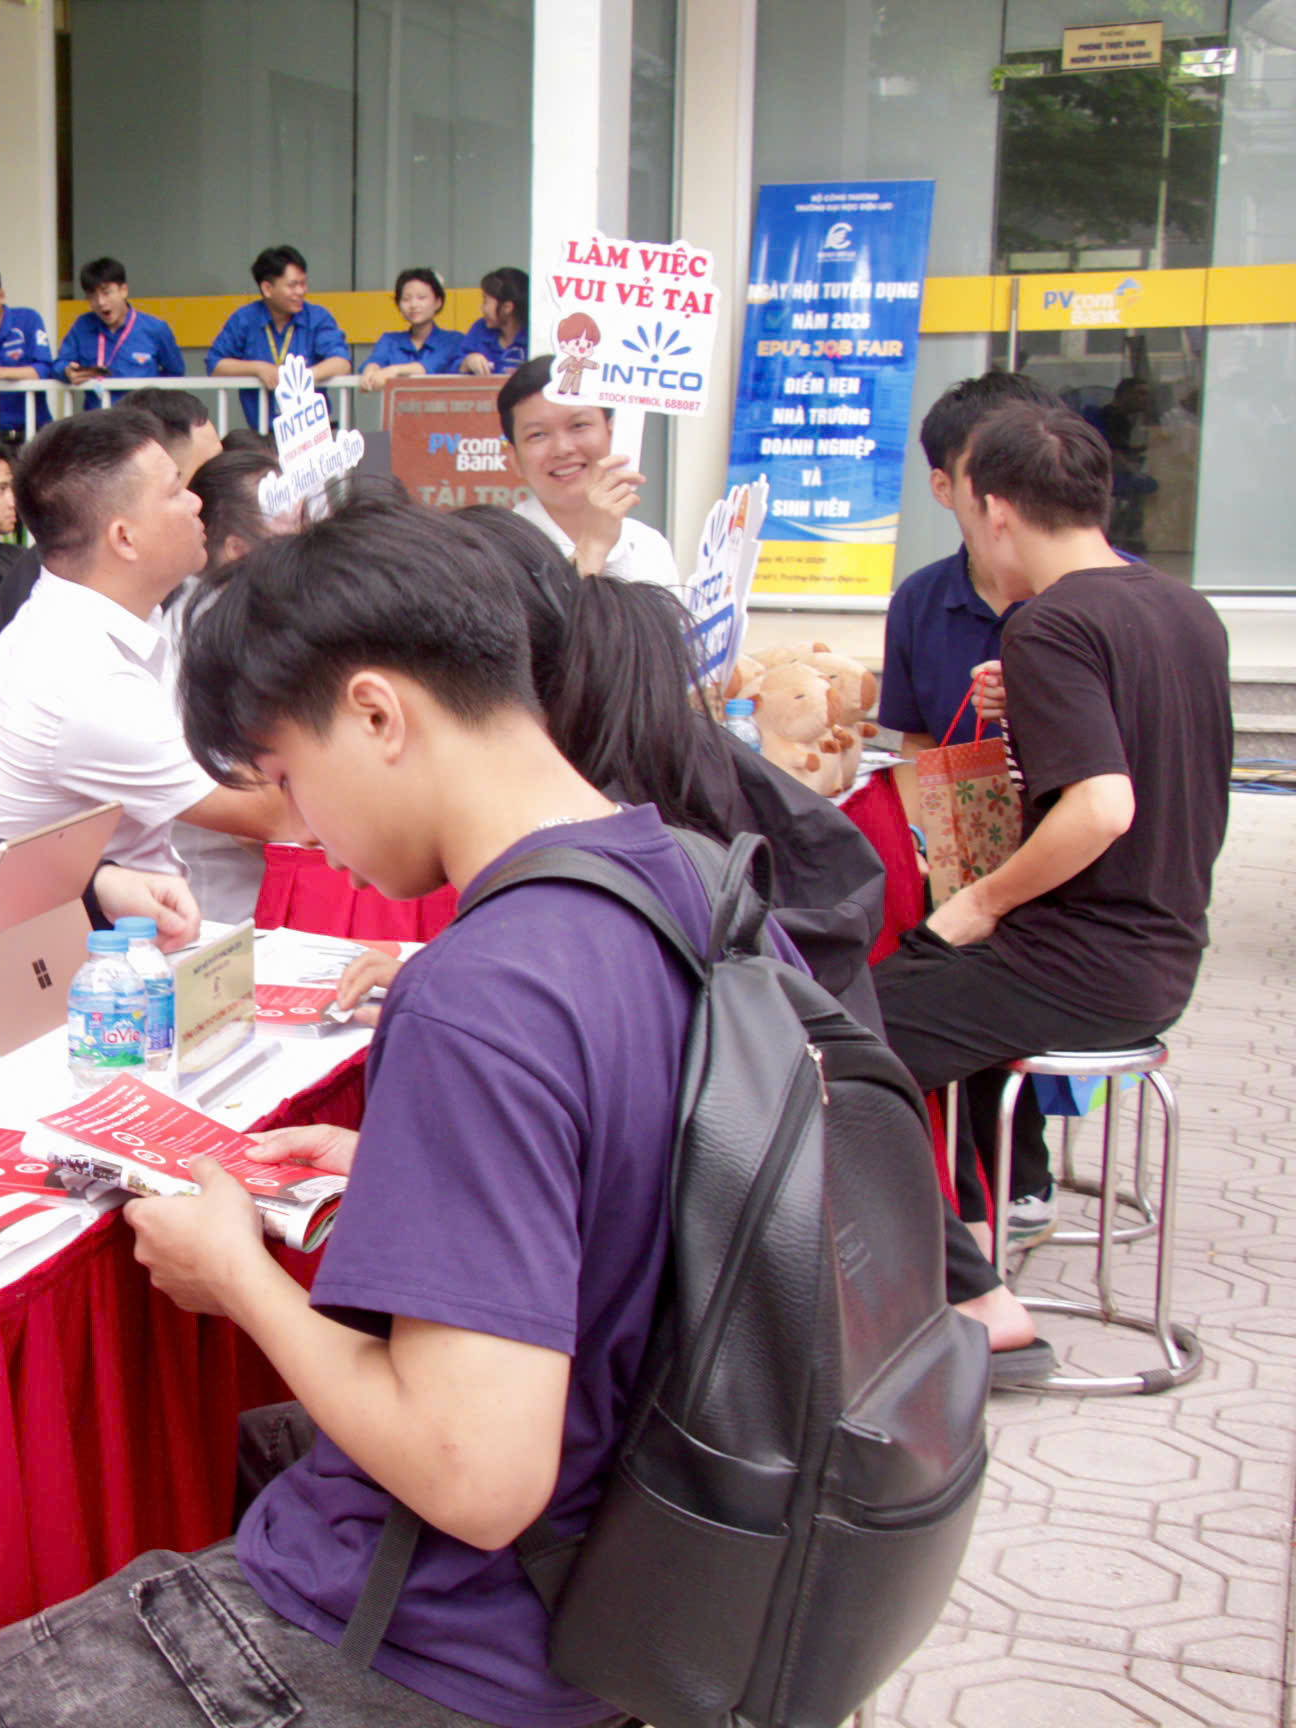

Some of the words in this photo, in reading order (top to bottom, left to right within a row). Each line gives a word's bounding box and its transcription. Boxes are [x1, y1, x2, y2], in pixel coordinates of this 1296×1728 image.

[566, 237, 630, 269] LÀM
[639, 248, 707, 282] VIỆC
[552, 276, 607, 302] VUI
[615, 277, 654, 308] VẺ
[662, 288, 714, 319] TẠI
[792, 280, 819, 303] HỘI
[823, 277, 873, 299] TUYỂN
[875, 282, 920, 302] DỤNG
[792, 310, 829, 330] NĂM
[757, 340, 810, 357] EPU's
[812, 340, 853, 357] JOB
[857, 340, 903, 357] FAIR
[602, 363, 703, 392] INTCO
[784, 371, 824, 394] ĐIỂM
[827, 377, 861, 398] HẸN
[599, 392, 626, 404] STOCK
[628, 395, 661, 408] SYMBOL
[664, 398, 701, 411] 688087
[279, 399, 326, 443] INTCO
[772, 405, 805, 425] NHÀ
[809, 404, 870, 425] TRƯỜNG
[428, 432, 502, 455] PVcom
[760, 438, 814, 455] DOANH
[817, 436, 876, 459] NGHIỆP
[456, 455, 507, 471] Bank
[802, 466, 822, 486] VÀ
[417, 480, 467, 506] TÀI
[772, 500, 811, 517] SINH
[813, 497, 851, 517] VIÊN
